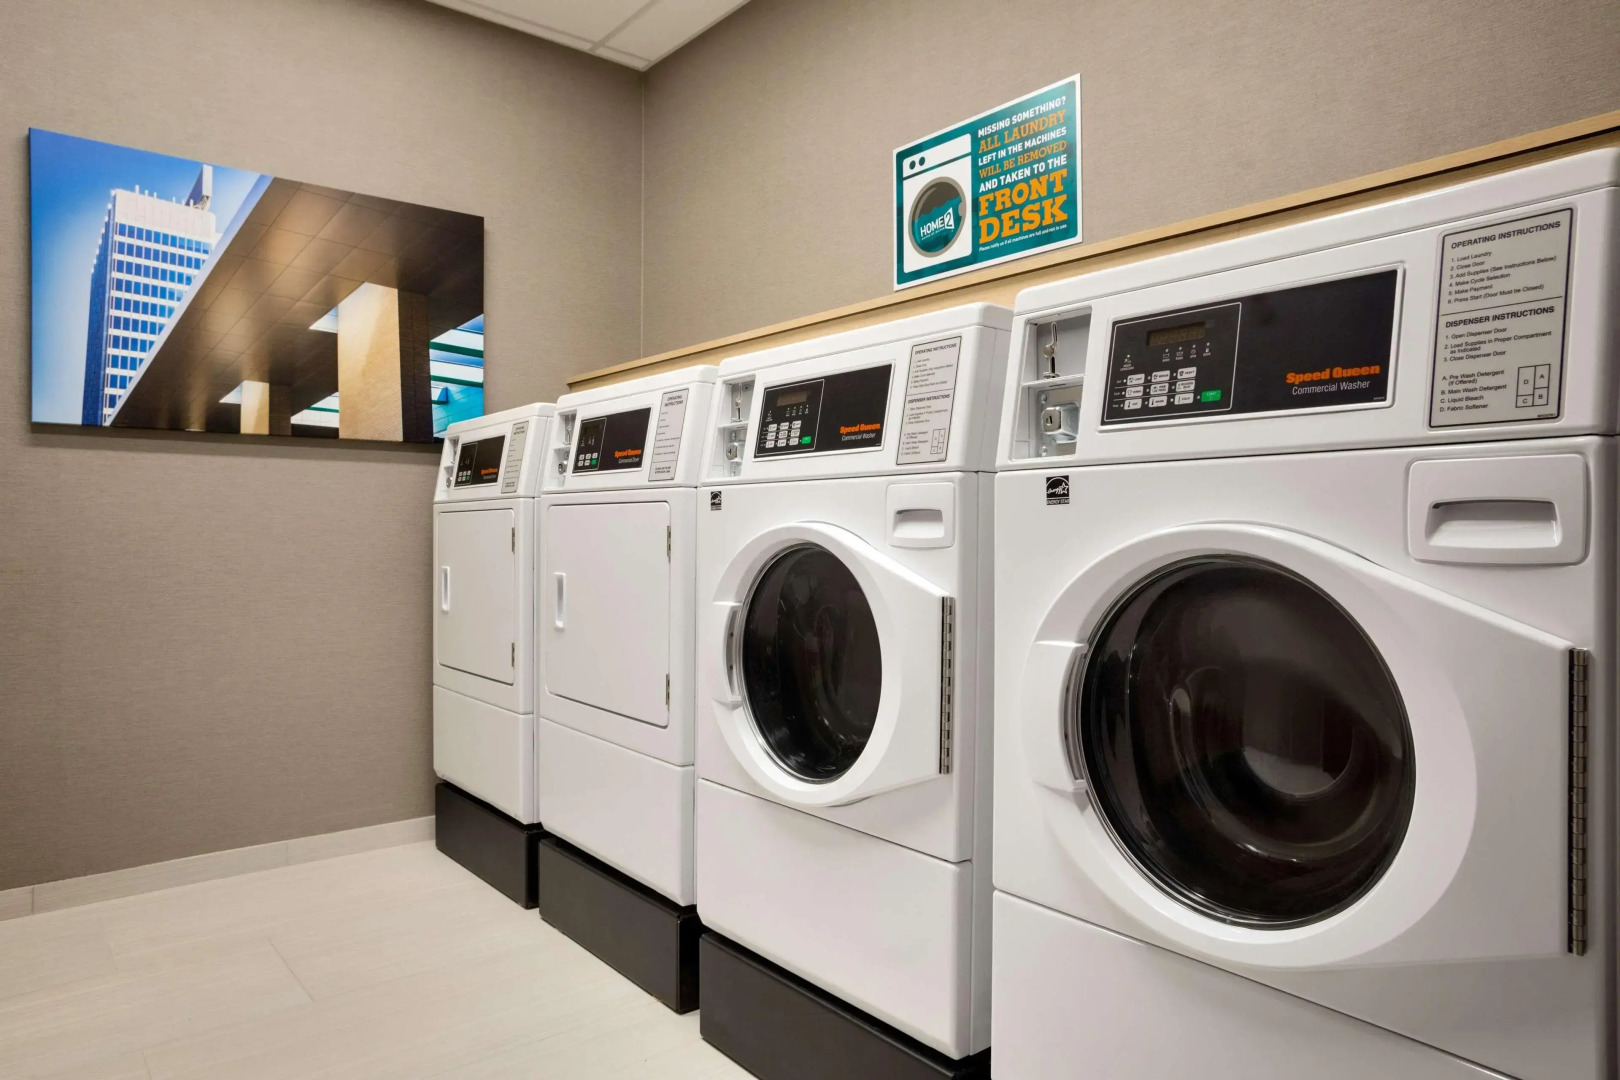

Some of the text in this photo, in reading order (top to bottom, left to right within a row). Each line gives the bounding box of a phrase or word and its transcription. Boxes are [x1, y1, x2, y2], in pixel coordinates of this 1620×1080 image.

[978, 96, 1065, 137] MISSING SOMETHING?
[979, 110, 1065, 154] ALL LAUNDRY
[979, 127, 1066, 166] LEFT IN THE MACHINES
[979, 140, 1066, 178] WILL BE REMOVED
[979, 154, 1066, 192] AND TAKEN TO THE
[979, 168, 1067, 216] FRONT
[979, 194, 1067, 244] DESK
[1451, 221, 1560, 249] OPERATING INSTRUCTIONS
[1471, 251, 1491, 259] Laundry
[1467, 268, 1489, 277] Supplies
[1490, 265, 1502, 273] (See
[1504, 260, 1535, 270] Instructions
[1536, 255, 1556, 264] Below)
[1470, 277, 1485, 285] Cycle
[1486, 273, 1510, 281] Selection
[1470, 285, 1492, 293] Payment
[1483, 292, 1498, 300] (Door
[1522, 284, 1544, 292] Closed)
[1446, 306, 1554, 328] DISPENSER INSTRUCTIONS
[1464, 339, 1486, 347] Supplies
[1494, 336, 1512, 344] Proper
[1513, 331, 1551, 341] Compartment
[1466, 329, 1492, 338] Dispenser
[1286, 365, 1380, 384] Speed Queen
[1292, 380, 1370, 395] Commercial Washer
[1479, 384, 1506, 392] Detergent
[840, 424, 859, 434] Speed
